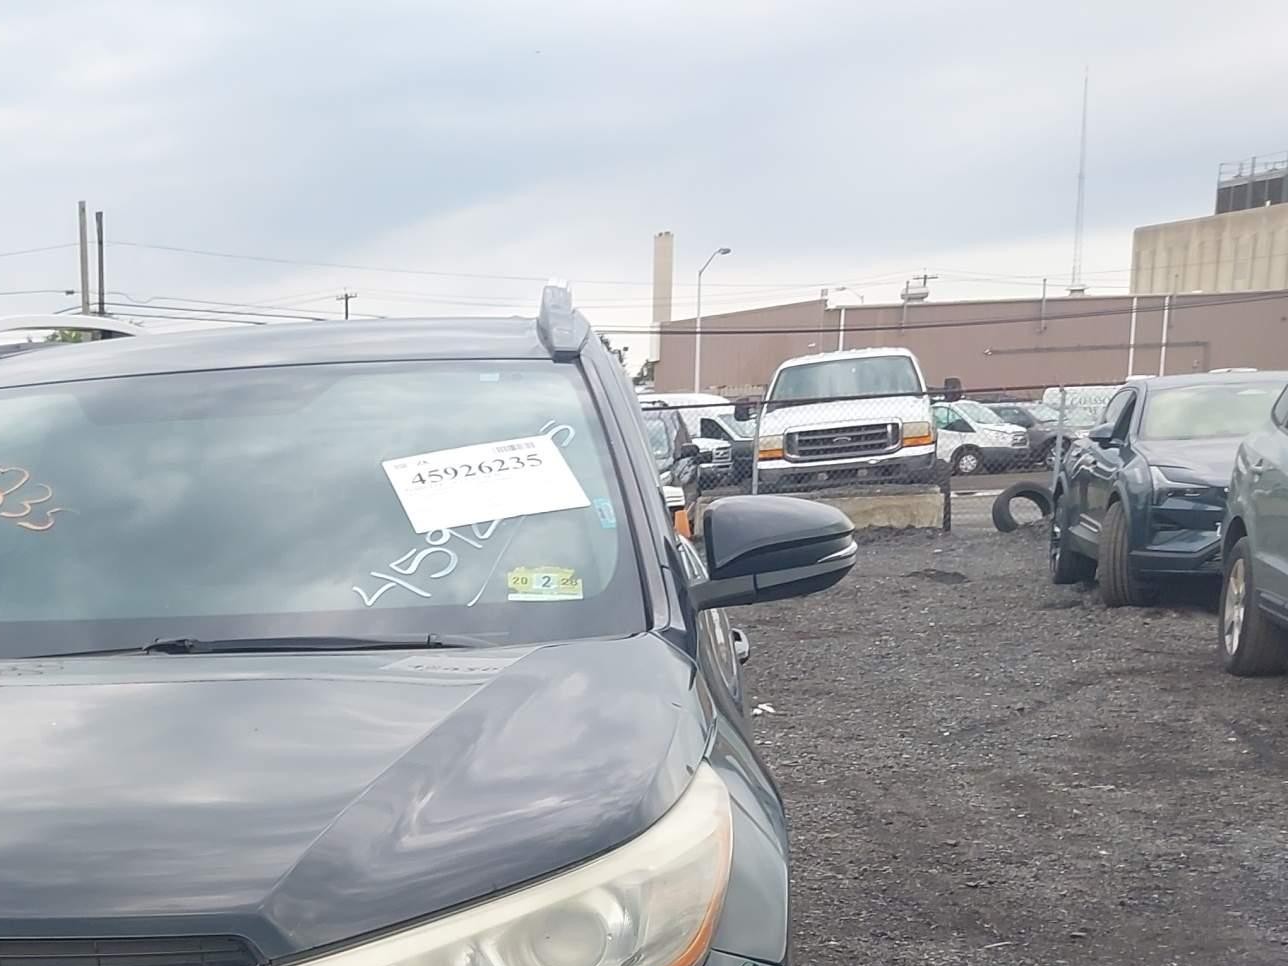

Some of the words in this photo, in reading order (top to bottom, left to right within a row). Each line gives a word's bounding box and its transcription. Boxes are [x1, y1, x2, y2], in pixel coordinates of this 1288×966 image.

[411, 453, 544, 485] 45926235
[512, 576, 528, 585] 20
[541, 575, 552, 587] 2
